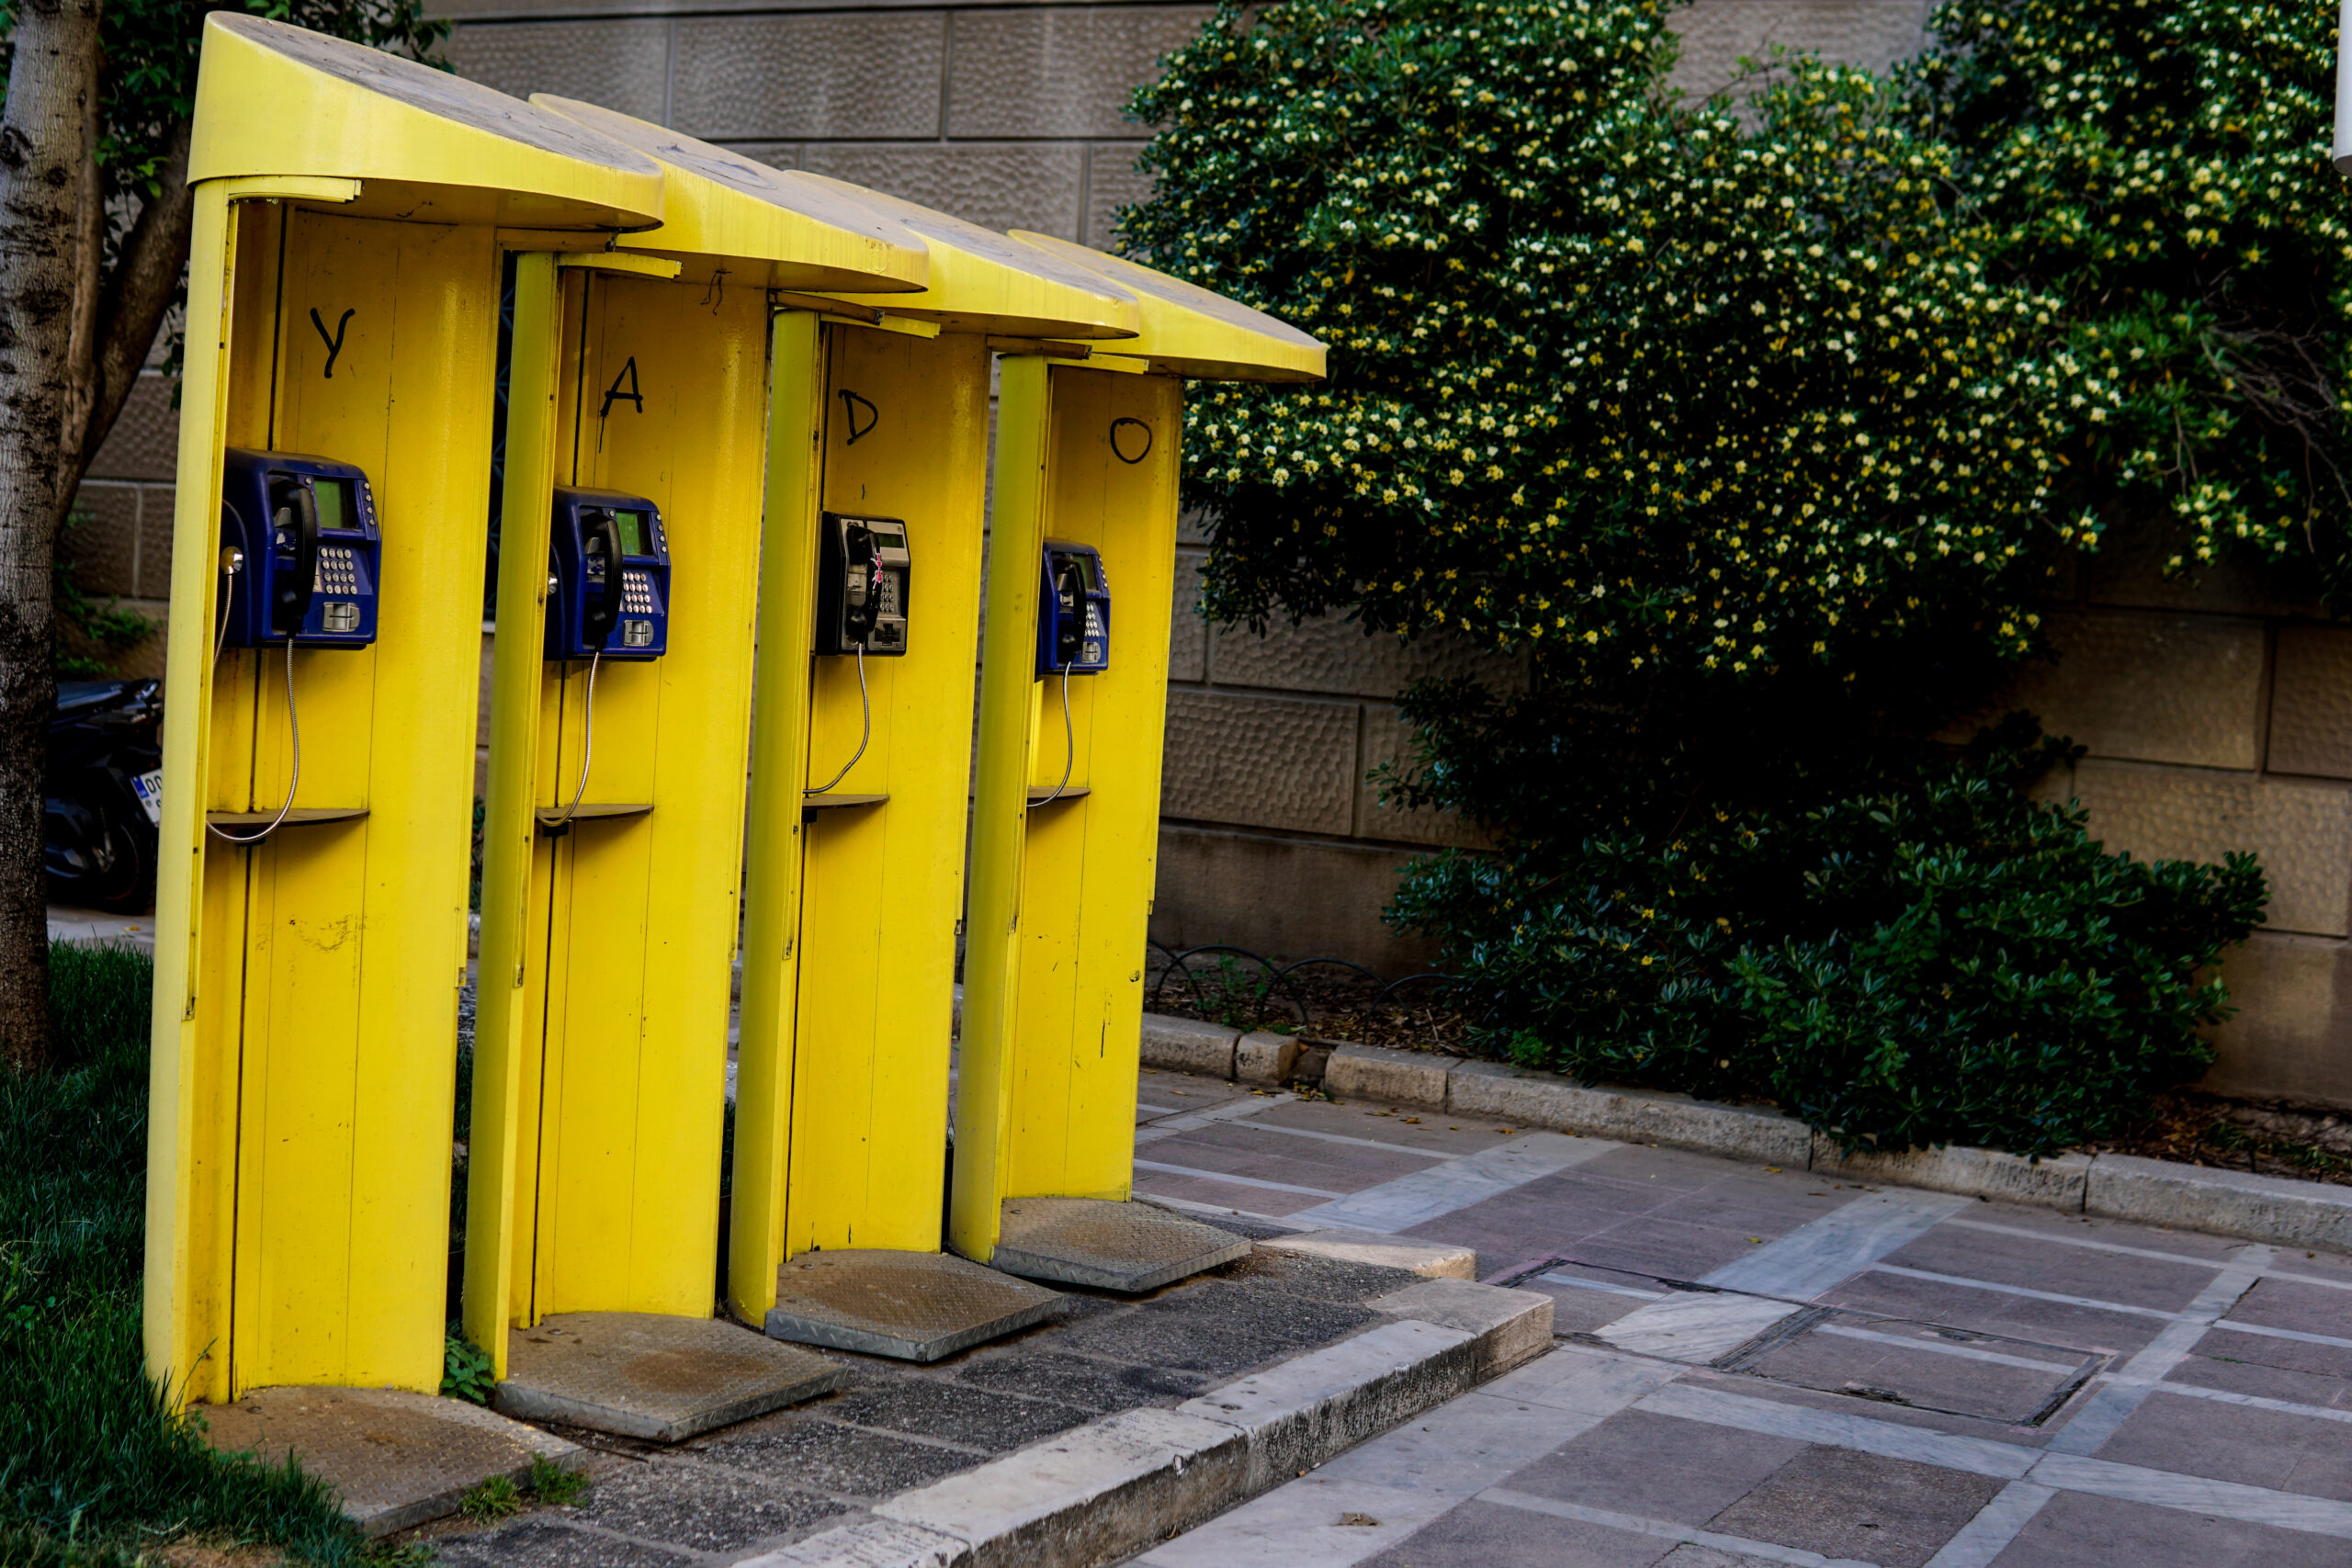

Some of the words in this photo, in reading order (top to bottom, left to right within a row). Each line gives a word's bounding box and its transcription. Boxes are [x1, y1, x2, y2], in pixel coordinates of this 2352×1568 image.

[310, 307, 356, 379] Y
[599, 355, 644, 421] A
[838, 389, 878, 446] D
[1109, 417, 1153, 465] O
